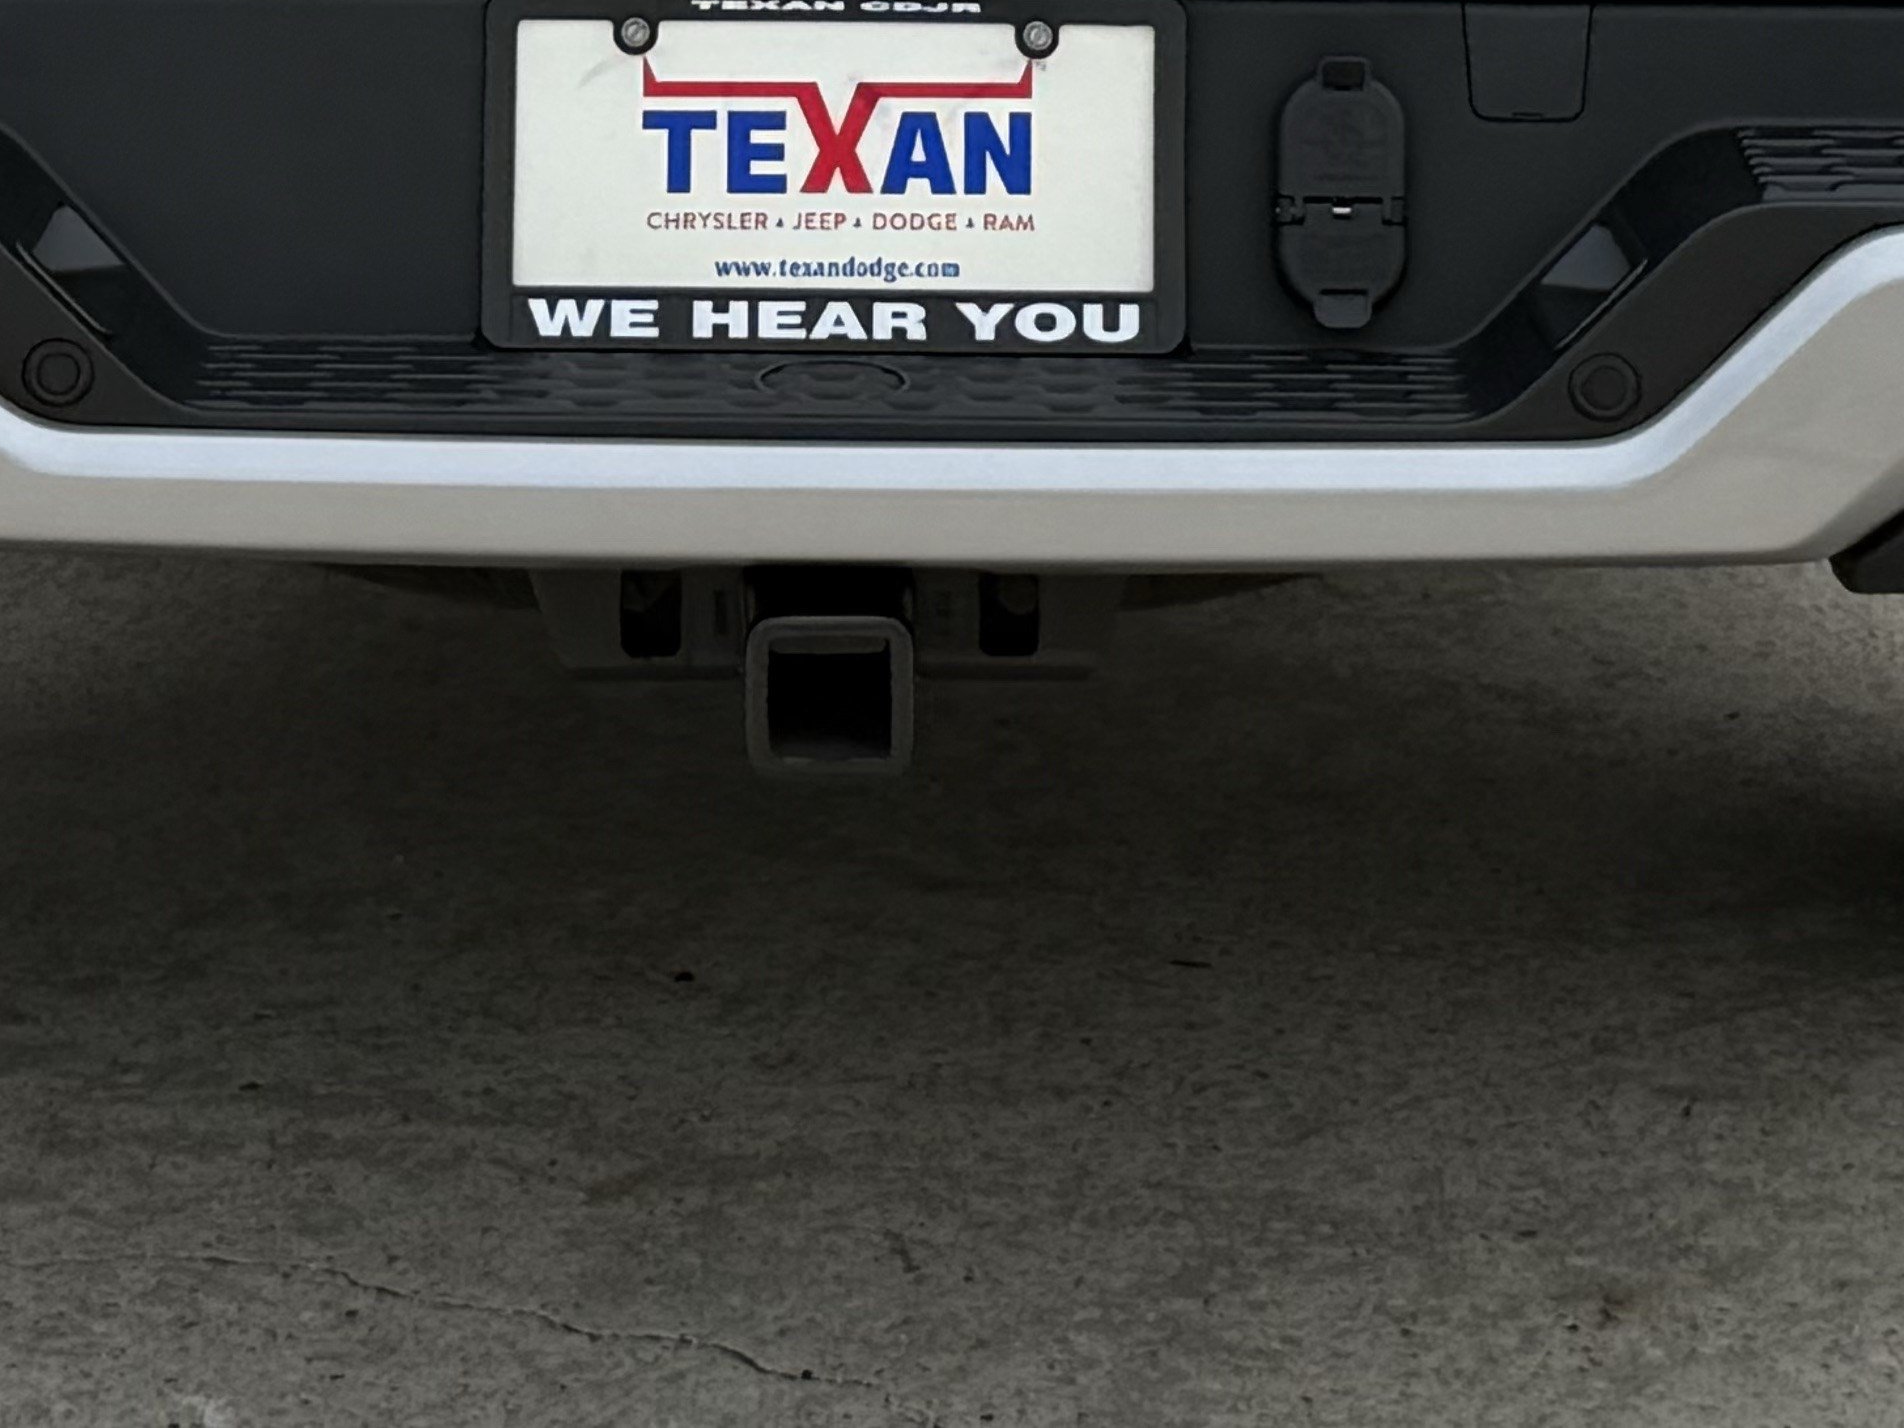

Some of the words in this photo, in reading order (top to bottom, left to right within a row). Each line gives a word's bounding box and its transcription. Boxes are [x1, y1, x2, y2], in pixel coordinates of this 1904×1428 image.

[642, 82, 1032, 195] TEXAN
[646, 211, 769, 231] CHRYSLER
[792, 212, 847, 231] JEEP
[871, 212, 958, 232] DODGE
[982, 213, 1036, 232] RAM
[714, 256, 961, 283] www.texandodge.com
[527, 298, 660, 338] WE
[693, 300, 928, 341] HEAR
[955, 302, 1141, 343] YOU
